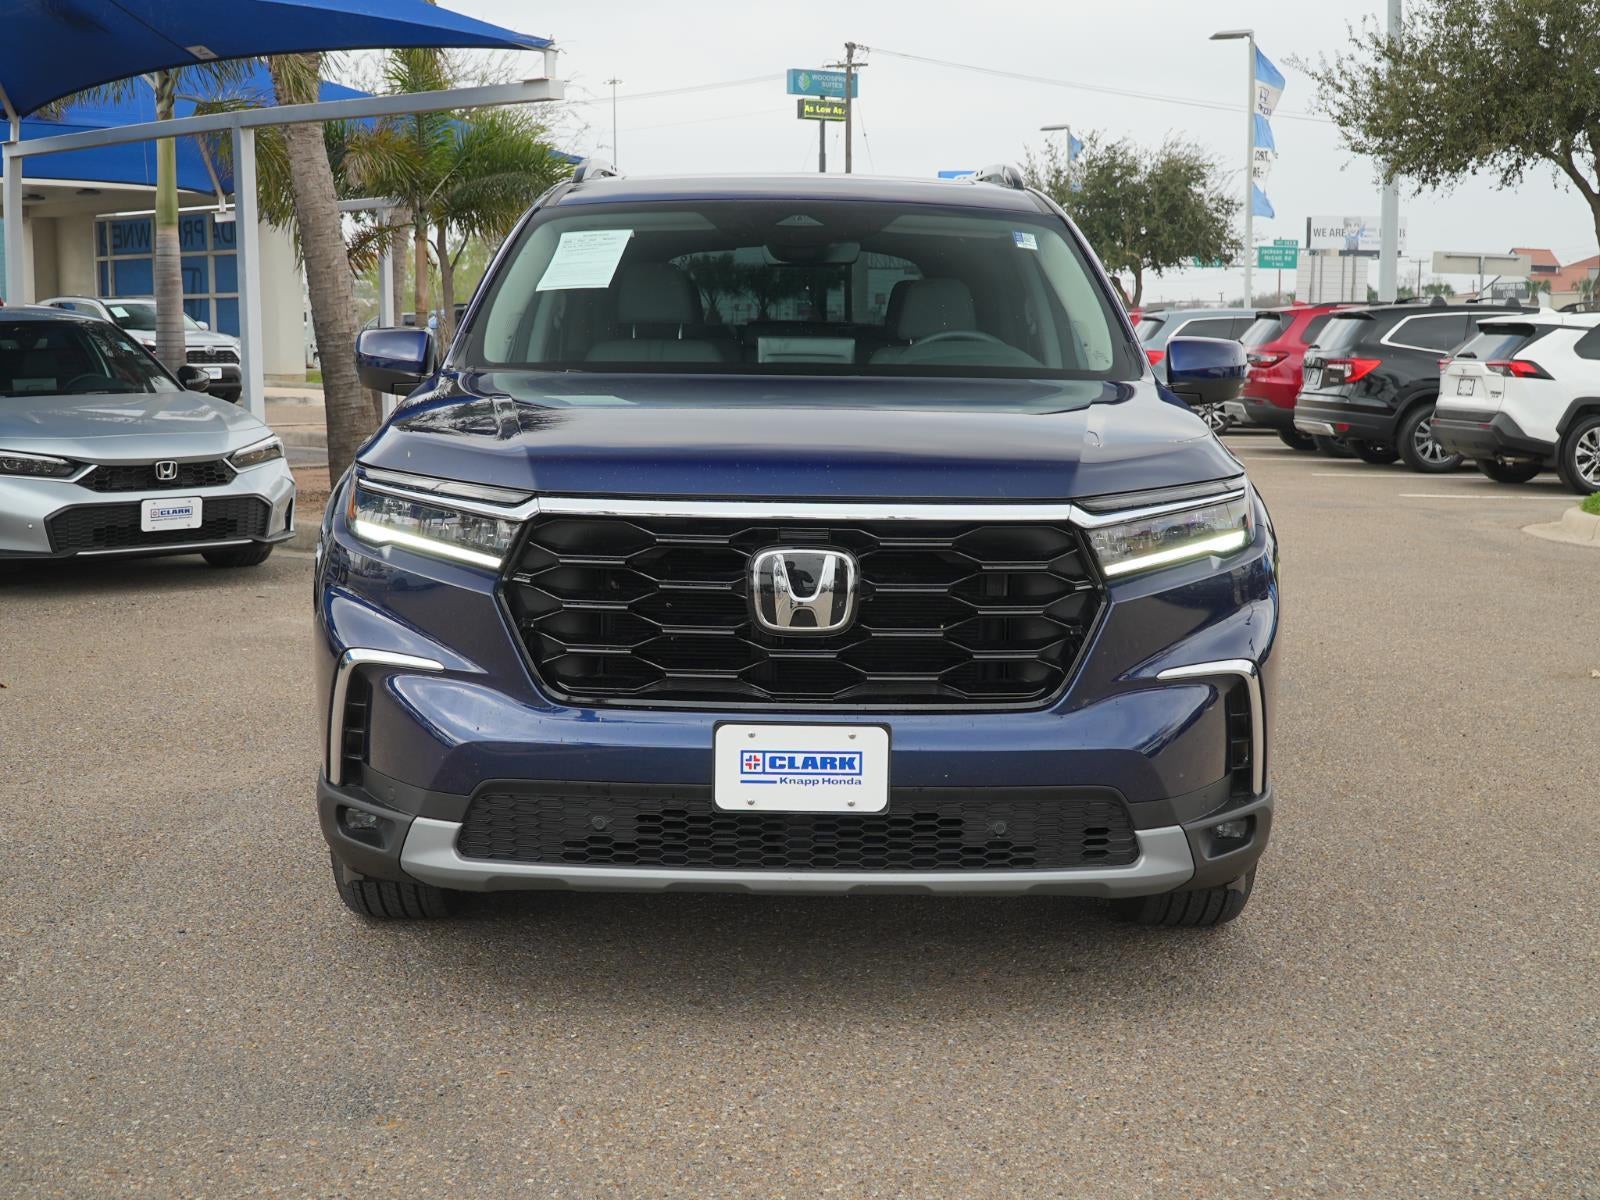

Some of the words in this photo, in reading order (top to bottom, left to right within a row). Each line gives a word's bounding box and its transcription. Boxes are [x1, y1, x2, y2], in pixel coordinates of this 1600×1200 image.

[804, 105, 814, 113] As
[816, 105, 831, 114] Low
[1313, 228, 1327, 237] WE
[1329, 228, 1345, 237] ARE
[160, 508, 190, 516] CLARK
[768, 756, 857, 770] CLARK
[779, 777, 820, 786] Knapp
[821, 777, 862, 785] Honda
